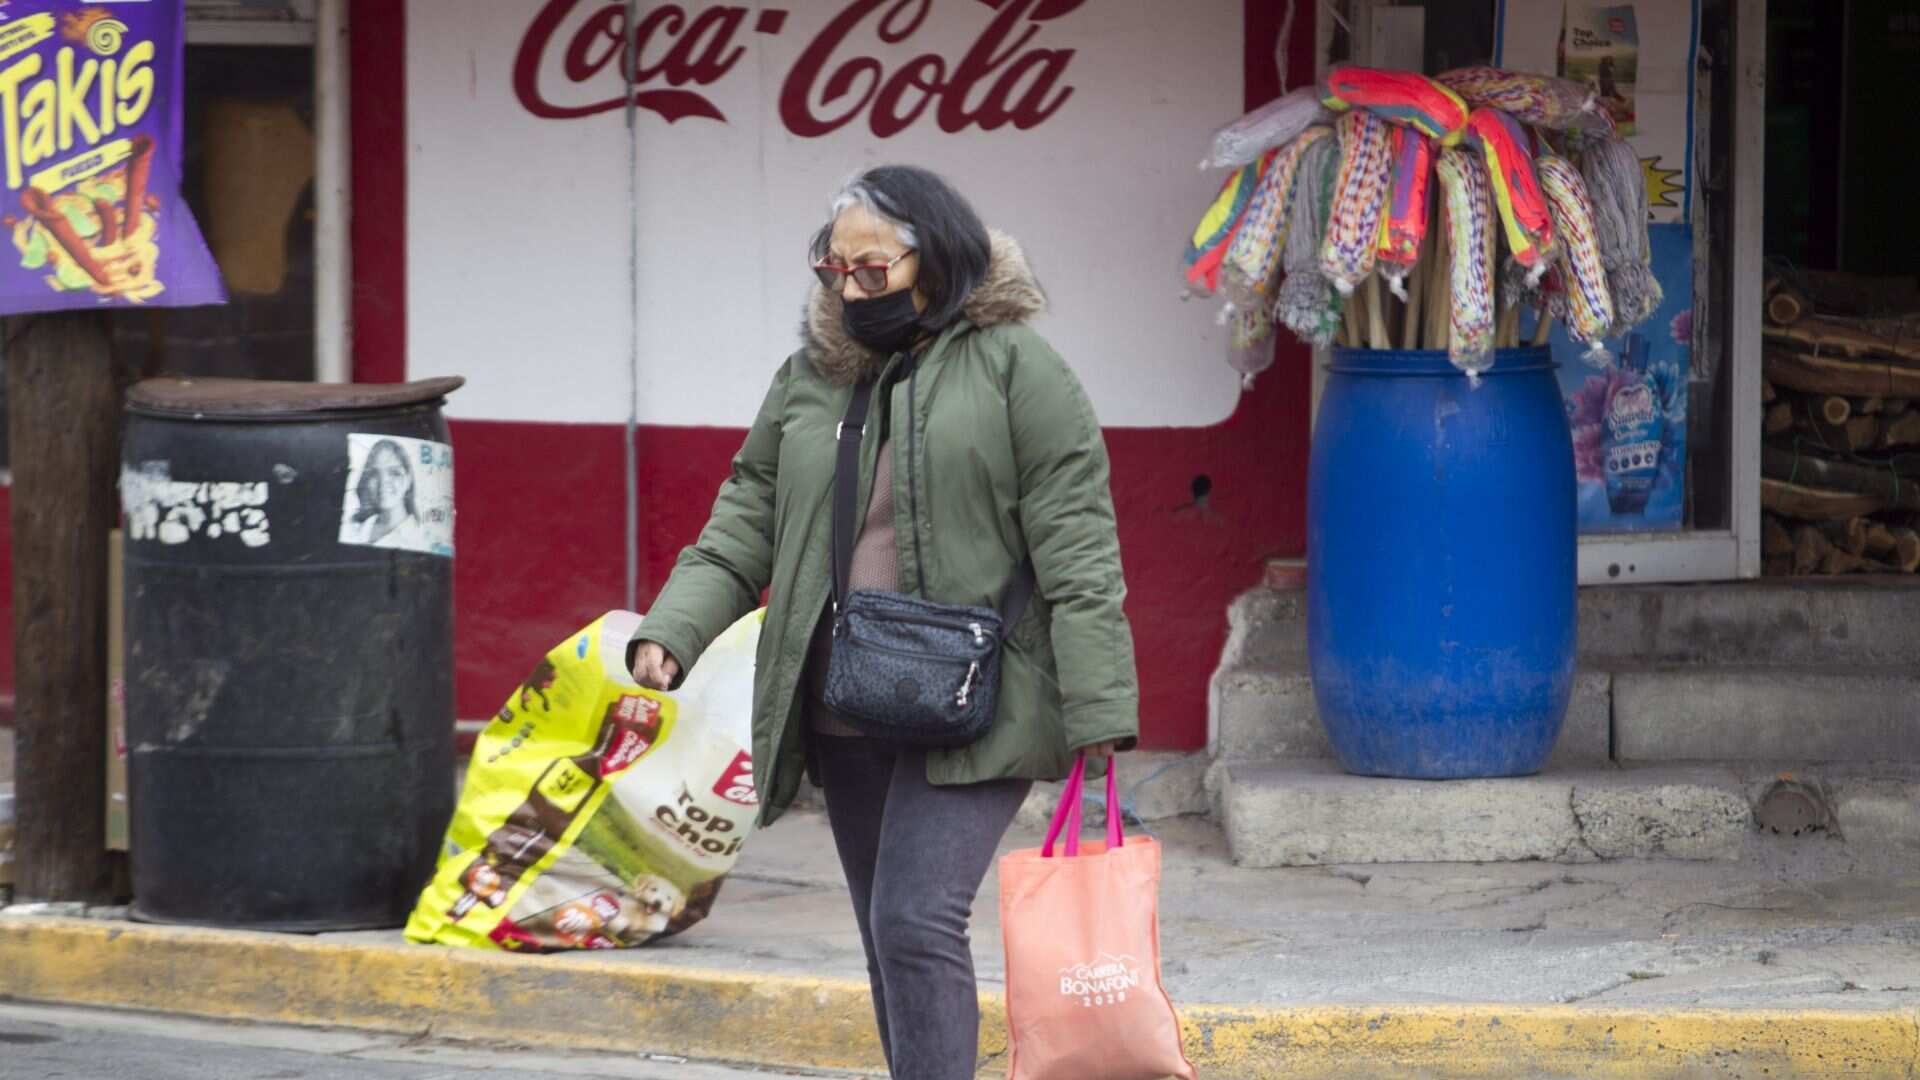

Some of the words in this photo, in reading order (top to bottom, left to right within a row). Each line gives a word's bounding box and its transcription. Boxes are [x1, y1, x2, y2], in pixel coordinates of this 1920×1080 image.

[1573, 26, 1594, 39] Top
[1572, 38, 1612, 50] Choice
[512, 0, 1076, 138] Coca-Cola
[0, 40, 154, 190] Takis
[1082, 991, 1126, 1008] 2020
